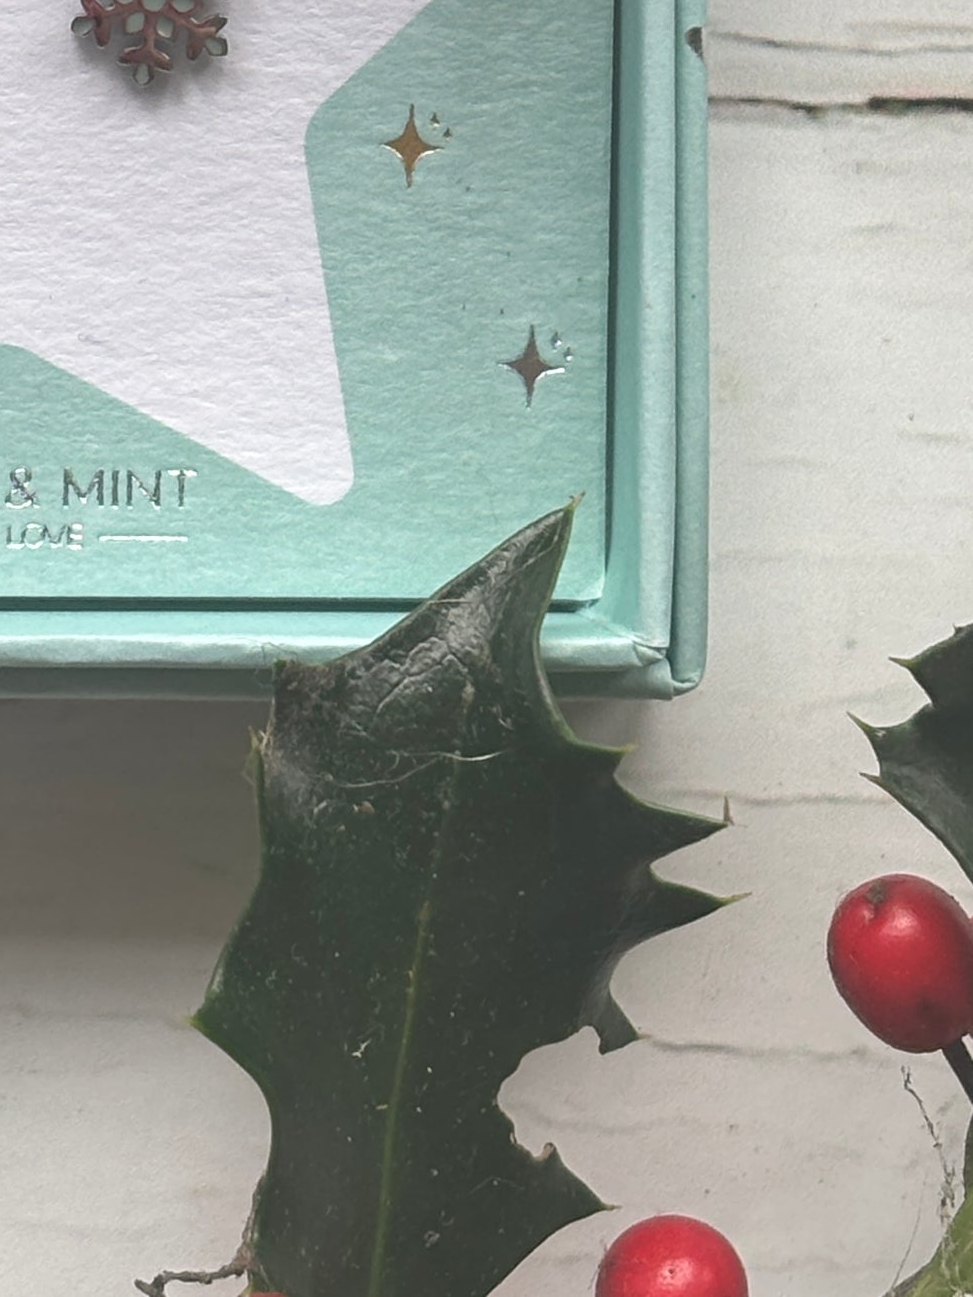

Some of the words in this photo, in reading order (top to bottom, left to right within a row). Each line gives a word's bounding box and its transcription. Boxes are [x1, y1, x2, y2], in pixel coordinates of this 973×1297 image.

[4, 466, 40, 509] &
[62, 467, 198, 510] MINT
[5, 523, 83, 550] LOVE
